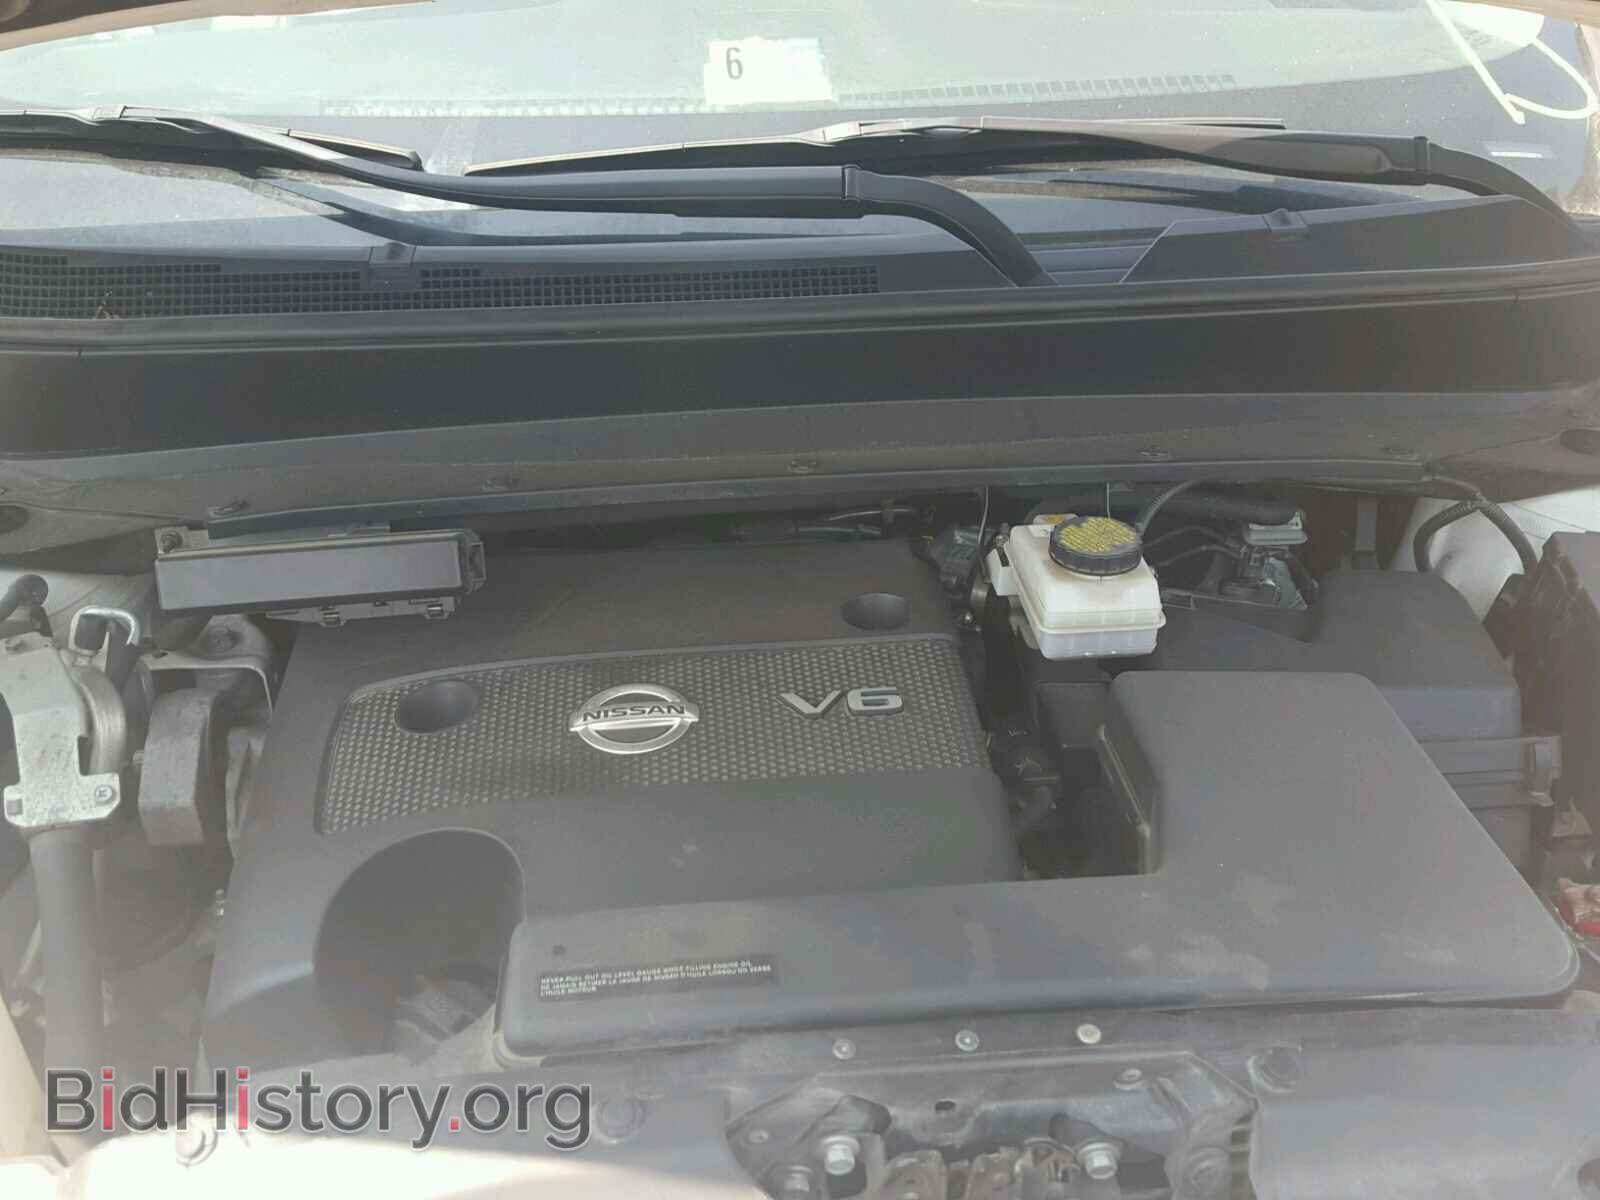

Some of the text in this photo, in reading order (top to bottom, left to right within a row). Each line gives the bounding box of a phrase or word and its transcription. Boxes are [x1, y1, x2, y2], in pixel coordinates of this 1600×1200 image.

[726, 47, 743, 79] 6
[583, 704, 685, 721] NISSAN
[779, 686, 904, 717] V6
